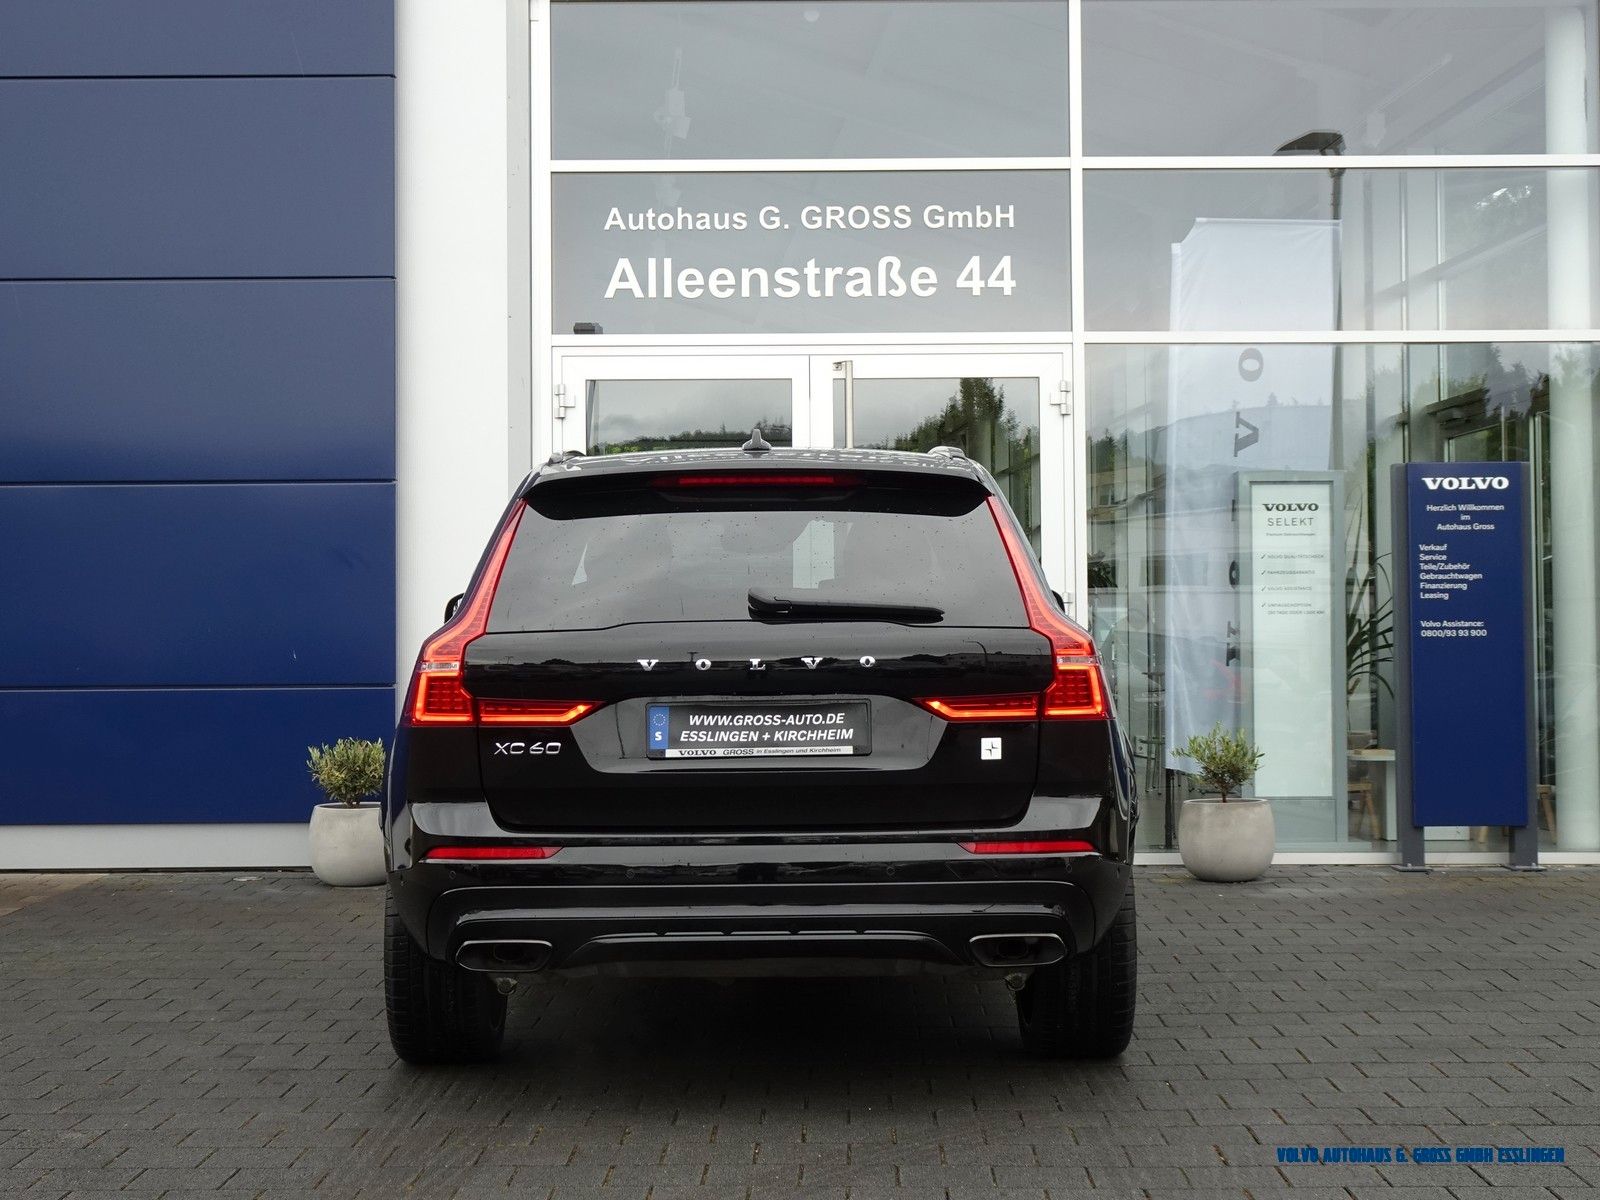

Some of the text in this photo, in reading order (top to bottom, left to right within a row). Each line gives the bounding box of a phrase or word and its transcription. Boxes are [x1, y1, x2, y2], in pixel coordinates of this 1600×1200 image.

[604, 204, 1016, 230] Autohaus G. GROSS GmbH
[604, 255, 1017, 298] Alleenstraße 44
[1421, 476, 1510, 490] VOLVO
[1262, 503, 1319, 511] VOLVO
[1267, 517, 1314, 526] SELEKT
[1419, 563, 1471, 571] Teile/Zubehör
[1419, 572, 1483, 581] Gebrauchtwagen
[1420, 582, 1468, 590] Finanzierung
[1420, 592, 1449, 600] Leasing
[1420, 630, 1457, 638] 0800/93
[637, 655, 876, 671] VOLVO
[689, 713, 845, 726] WWW.GROSS-AUTO.DE
[654, 731, 663, 741] S
[680, 730, 759, 742] ESSLINGEN
[774, 729, 854, 742] KIRCHHEIM
